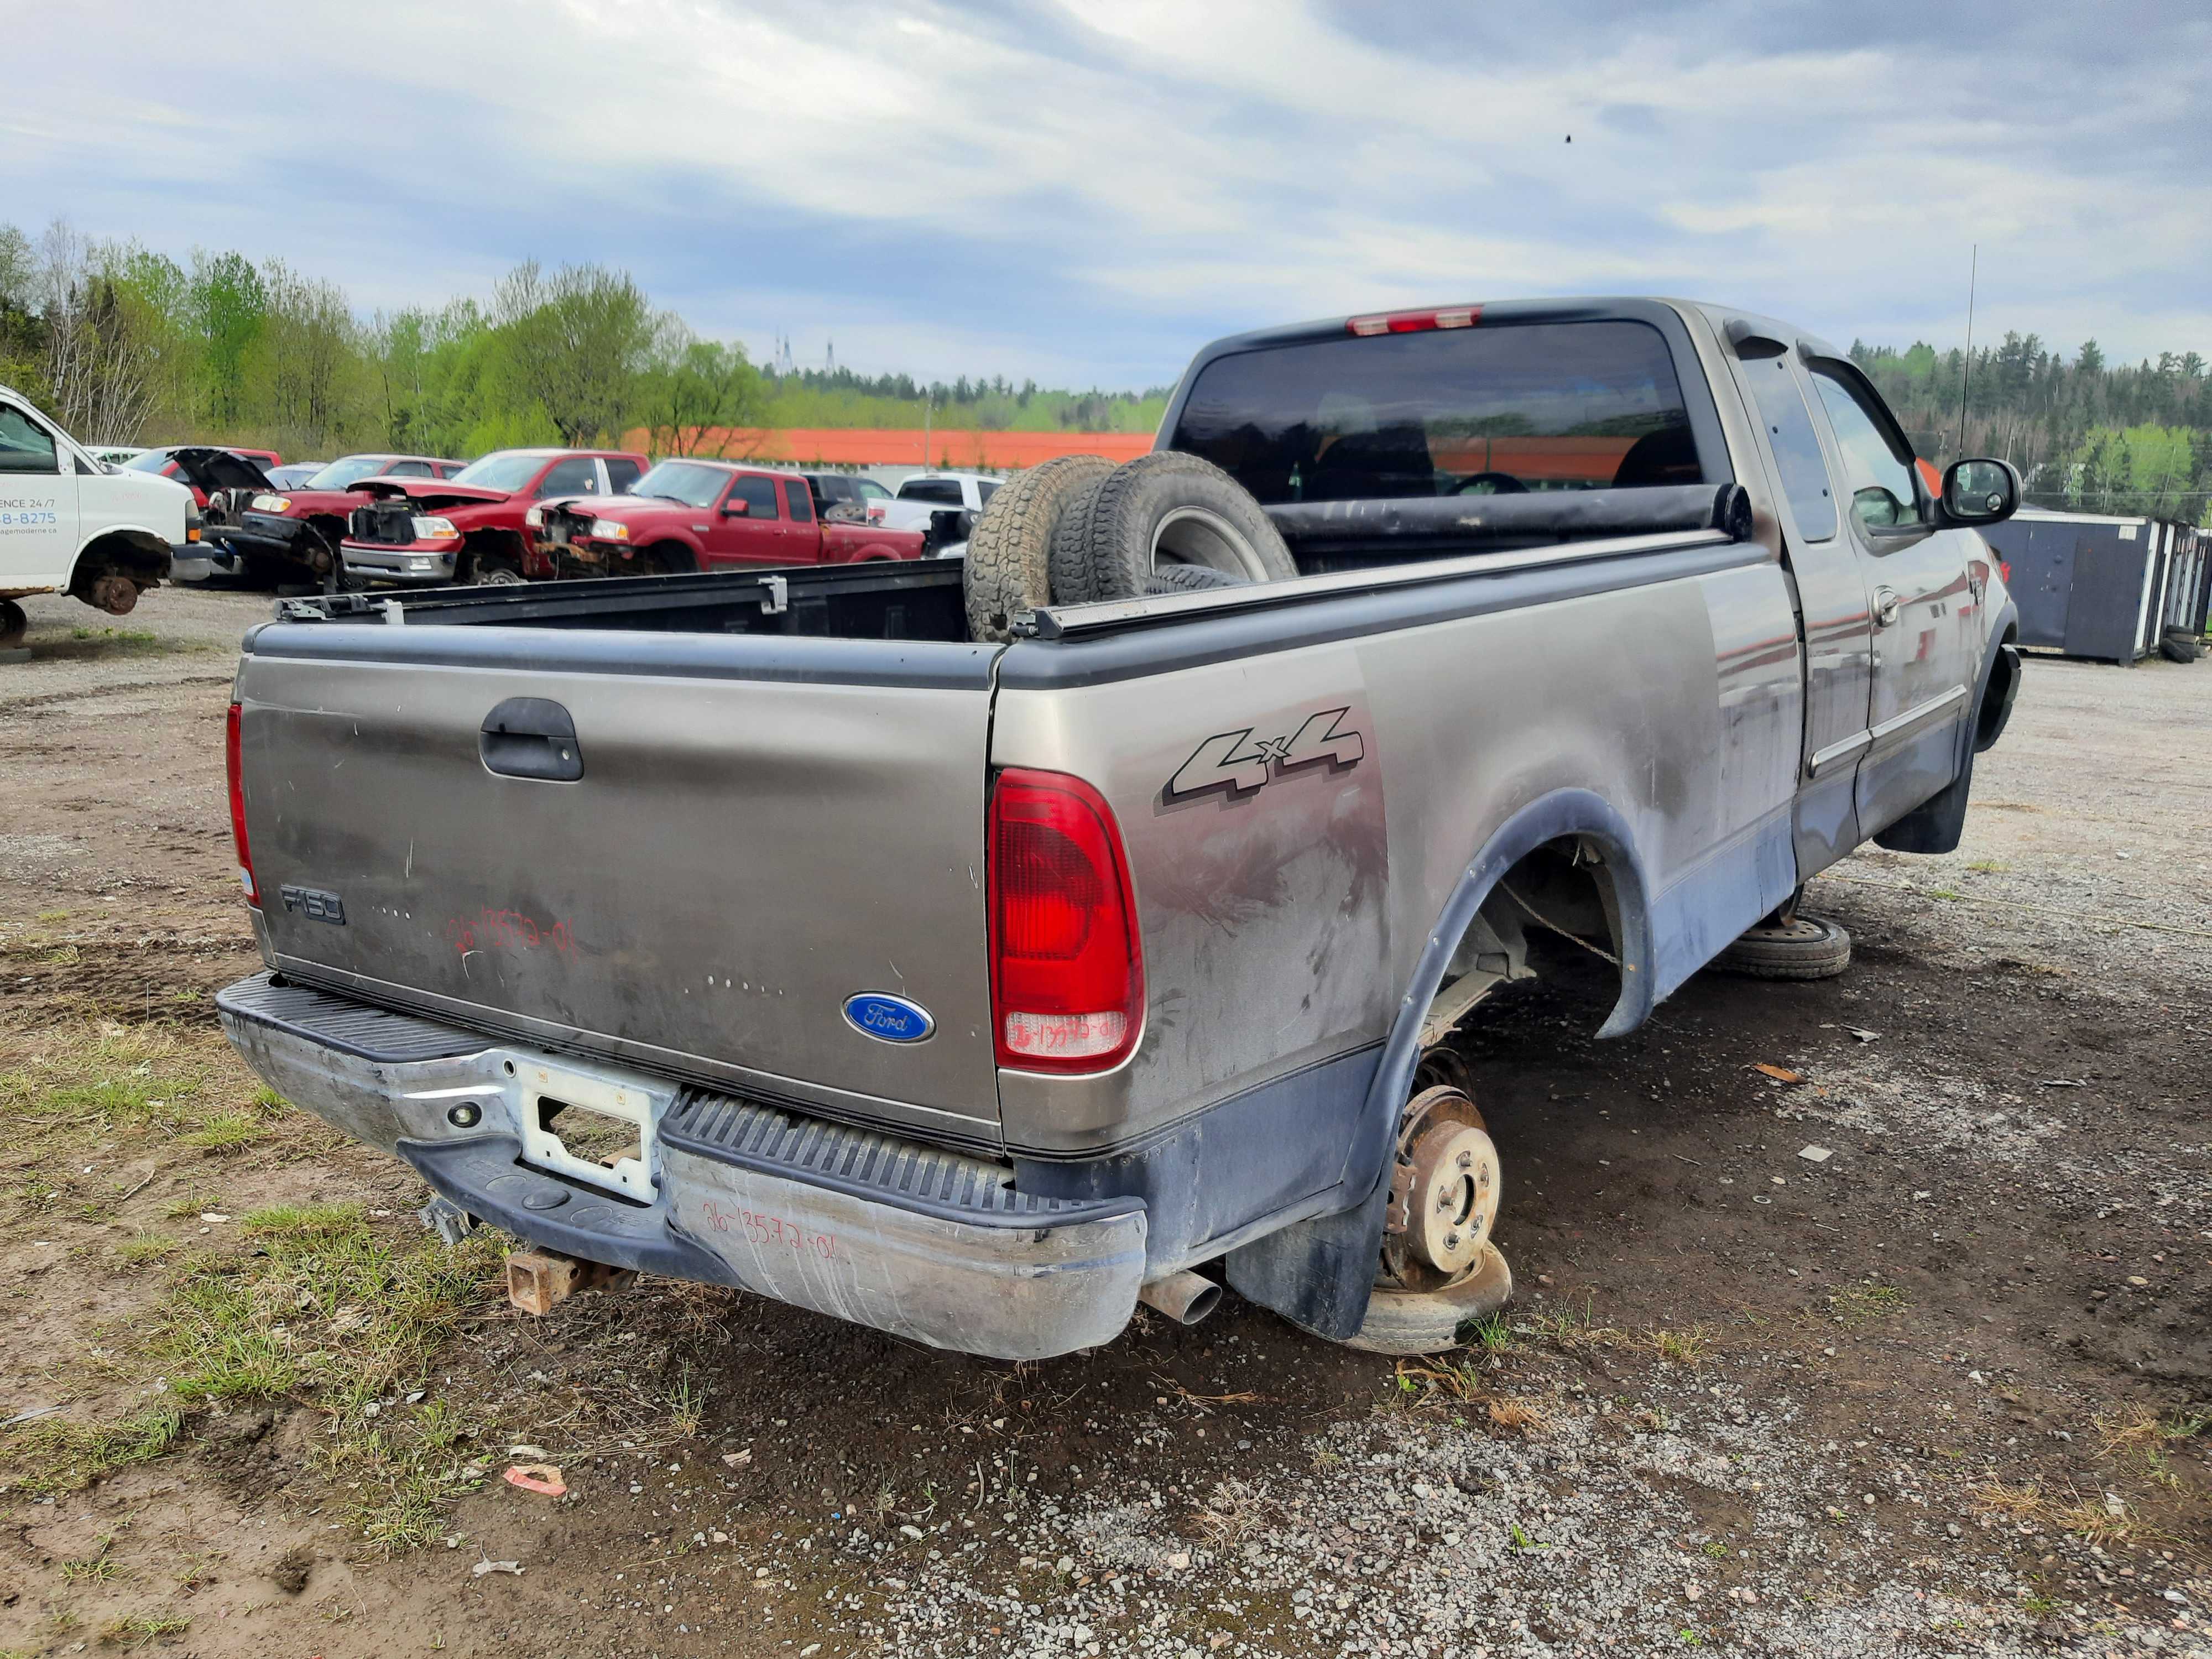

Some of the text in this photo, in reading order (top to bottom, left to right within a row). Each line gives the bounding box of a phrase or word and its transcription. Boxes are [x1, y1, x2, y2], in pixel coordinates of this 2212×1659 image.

[0, 513, 56, 524] 8-8275
[1164, 706, 1364, 805] 4x4
[864, 1003, 909, 1032] Ford
